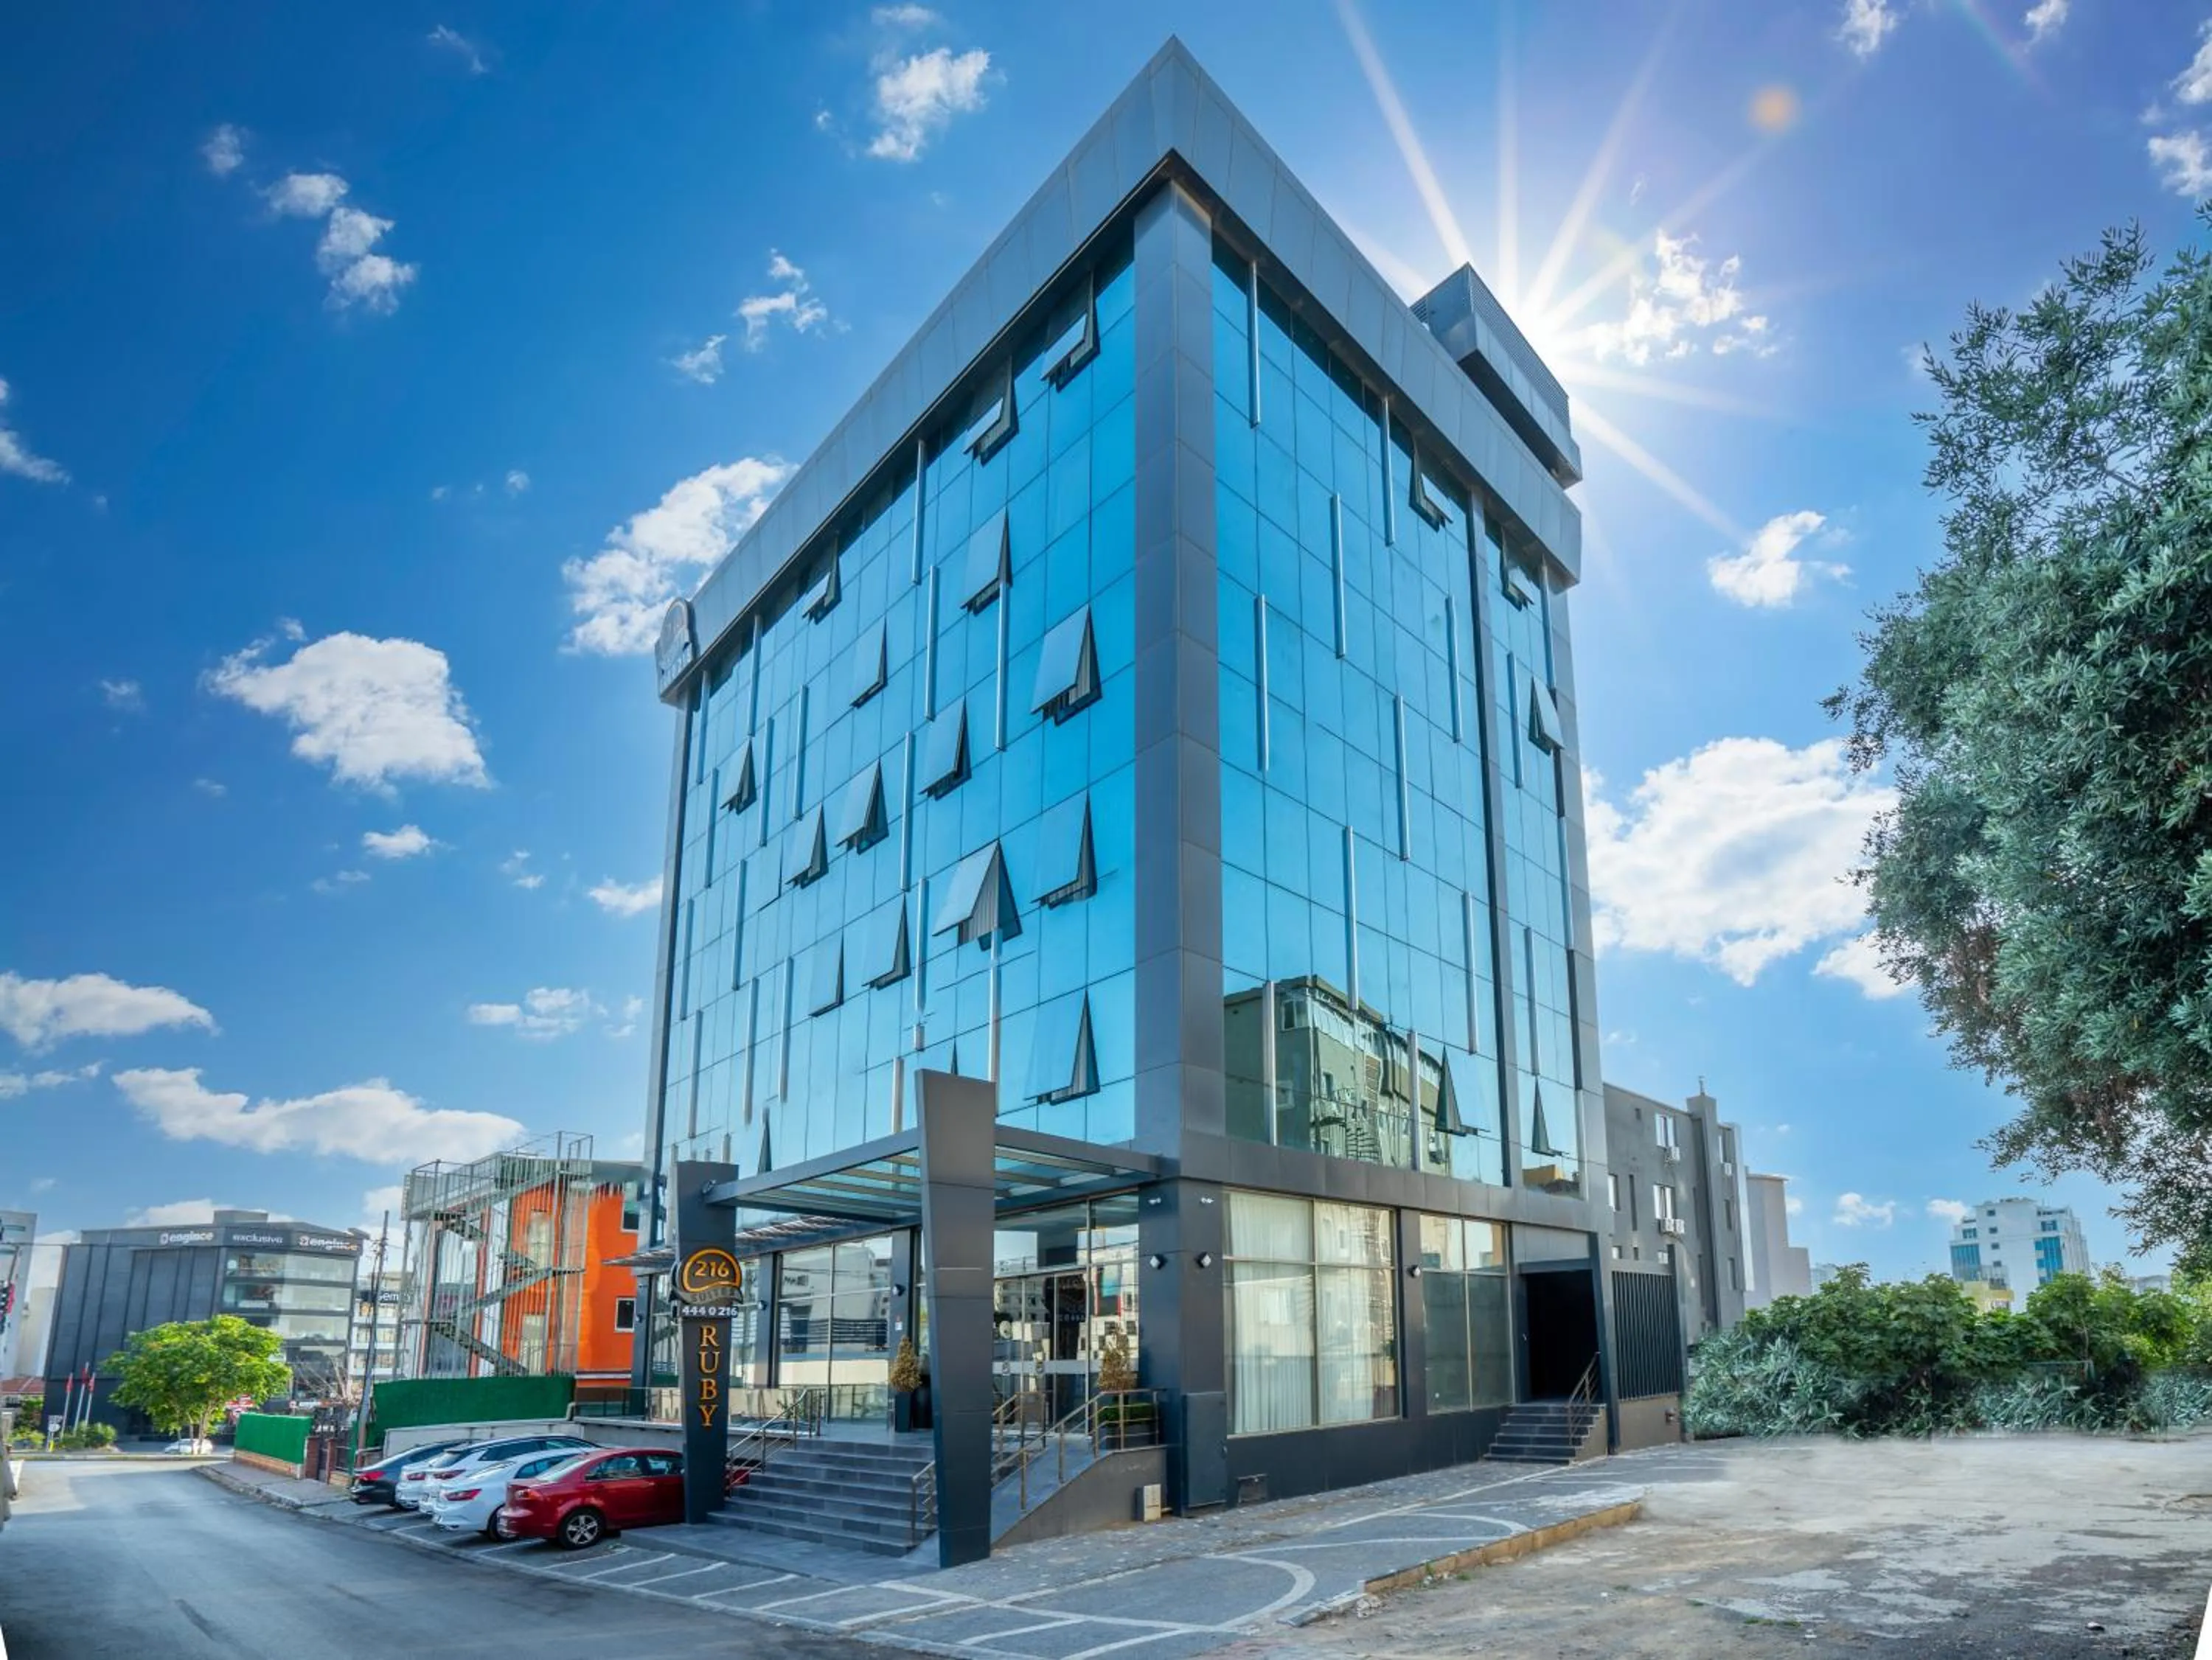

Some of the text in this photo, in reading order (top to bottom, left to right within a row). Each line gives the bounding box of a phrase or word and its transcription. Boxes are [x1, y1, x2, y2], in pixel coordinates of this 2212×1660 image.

[695, 1260, 729, 1277] 216
[681, 1305, 737, 1317] 444 0 216
[699, 1325, 720, 1427] RUBY
